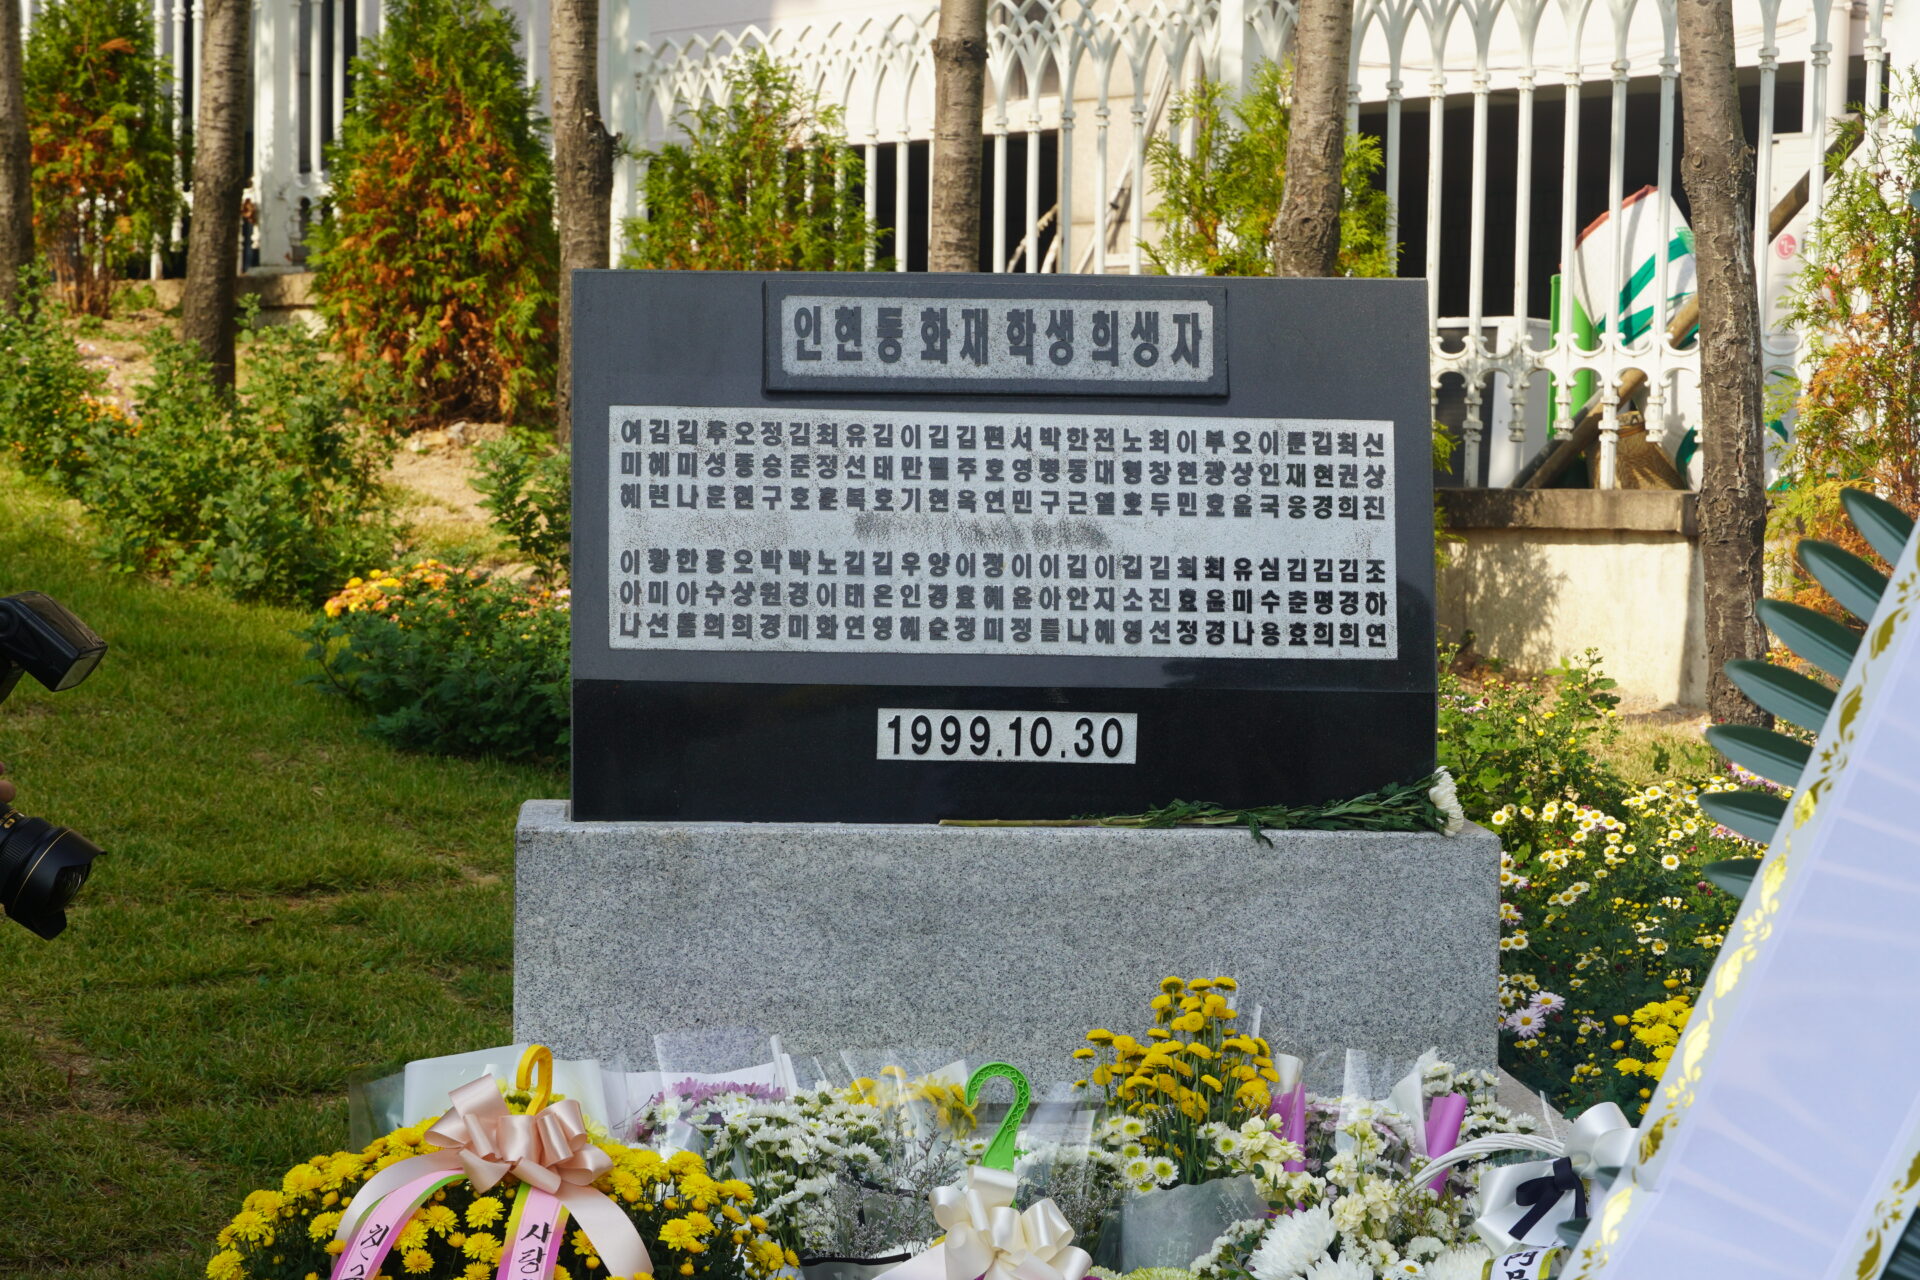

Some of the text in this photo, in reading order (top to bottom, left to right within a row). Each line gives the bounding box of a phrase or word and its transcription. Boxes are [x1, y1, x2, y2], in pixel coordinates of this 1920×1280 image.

[794, 306, 1202, 368] 인현동 화재 학생 희생자
[620, 420, 642, 508] 여미혜
[648, 419, 670, 508] 김혜련
[677, 420, 699, 509] 김미나
[733, 422, 755, 509] 오종현
[761, 422, 782, 510] 정승구
[789, 423, 811, 510] 김준호
[873, 424, 894, 511] 김태호
[900, 425, 922, 513] 이만기
[1012, 427, 1033, 513] 서영민
[1039, 428, 1061, 514] 박병구
[1067, 428, 1088, 514] 한동근
[1094, 428, 1115, 515] 전대열
[1149, 430, 1171, 516] 최창두
[1177, 431, 1198, 516] 이현민
[1258, 431, 1280, 518] 이인국
[1312, 432, 1334, 519] 김현경
[1363, 434, 1386, 520] 신상진
[619, 550, 642, 638] 이아나
[676, 549, 699, 638] 한아름
[731, 550, 756, 639] 오상희
[759, 550, 783, 639] 박원경
[788, 550, 811, 640] 박경미
[816, 551, 838, 640] 노이화
[844, 551, 865, 640] 김태연
[872, 552, 893, 640] 김은영
[900, 553, 921, 641] 우인혜
[928, 553, 951, 640] 양경순
[955, 553, 976, 642] 이효정
[983, 553, 1004, 642] 정혜미
[1011, 554, 1032, 643] 이윤정
[1038, 555, 1061, 642] 이아름
[1067, 555, 1089, 644] 김안나
[1094, 555, 1115, 644] 이지혜
[1122, 555, 1143, 644] 김소영
[1149, 556, 1171, 644] 김진선
[1177, 557, 1198, 645] 최효정
[1204, 557, 1226, 646] 최윤경
[1232, 558, 1255, 646] 유미나
[1259, 558, 1281, 646] 심수용
[1313, 559, 1334, 647] 김명희
[1338, 559, 1360, 647] 김경희
[1364, 560, 1387, 648] 조하연
[887, 714, 1123, 759] 1999.10.30
